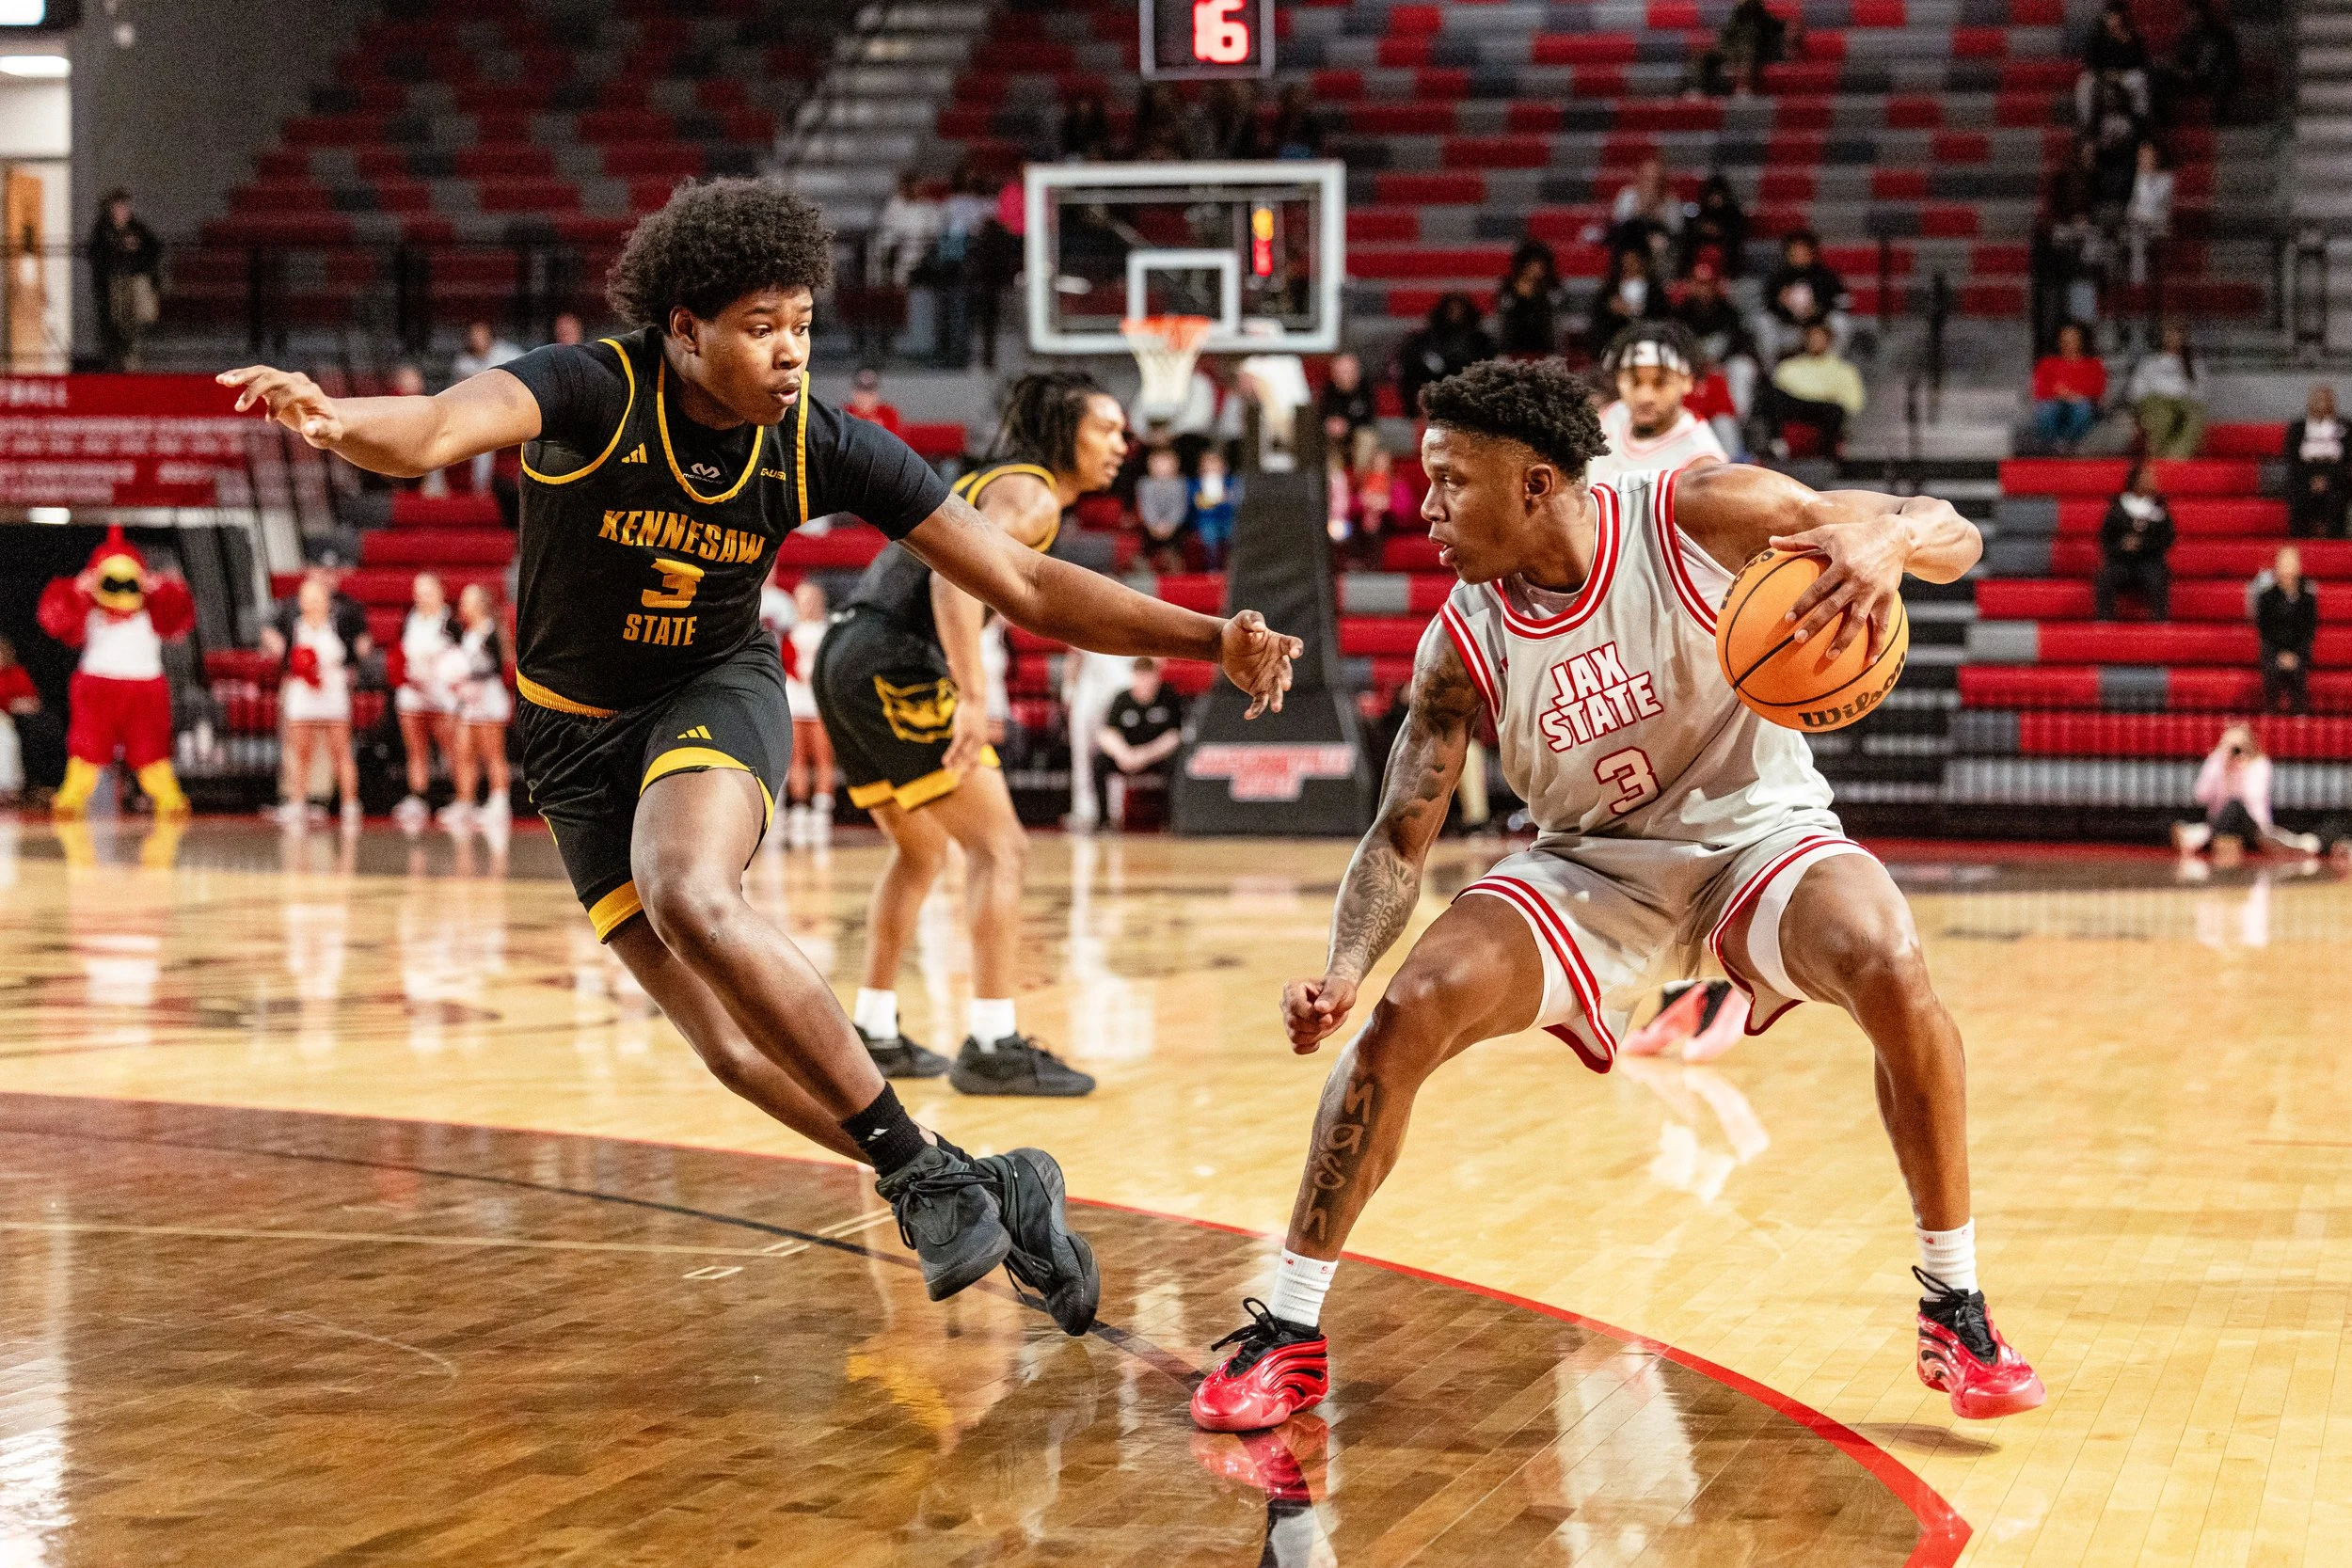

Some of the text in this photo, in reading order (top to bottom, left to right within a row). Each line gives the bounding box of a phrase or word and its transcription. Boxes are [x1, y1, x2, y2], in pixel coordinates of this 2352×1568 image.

[1193, 0, 1249, 64] 16
[597, 509, 766, 564] KENNESAW
[641, 558, 705, 609] 3
[623, 613, 698, 647] STATE
[1550, 640, 1629, 708] JAX
[1798, 650, 1907, 728] Wilson
[1539, 670, 1665, 753] STATE
[1593, 745, 1663, 816] 3
